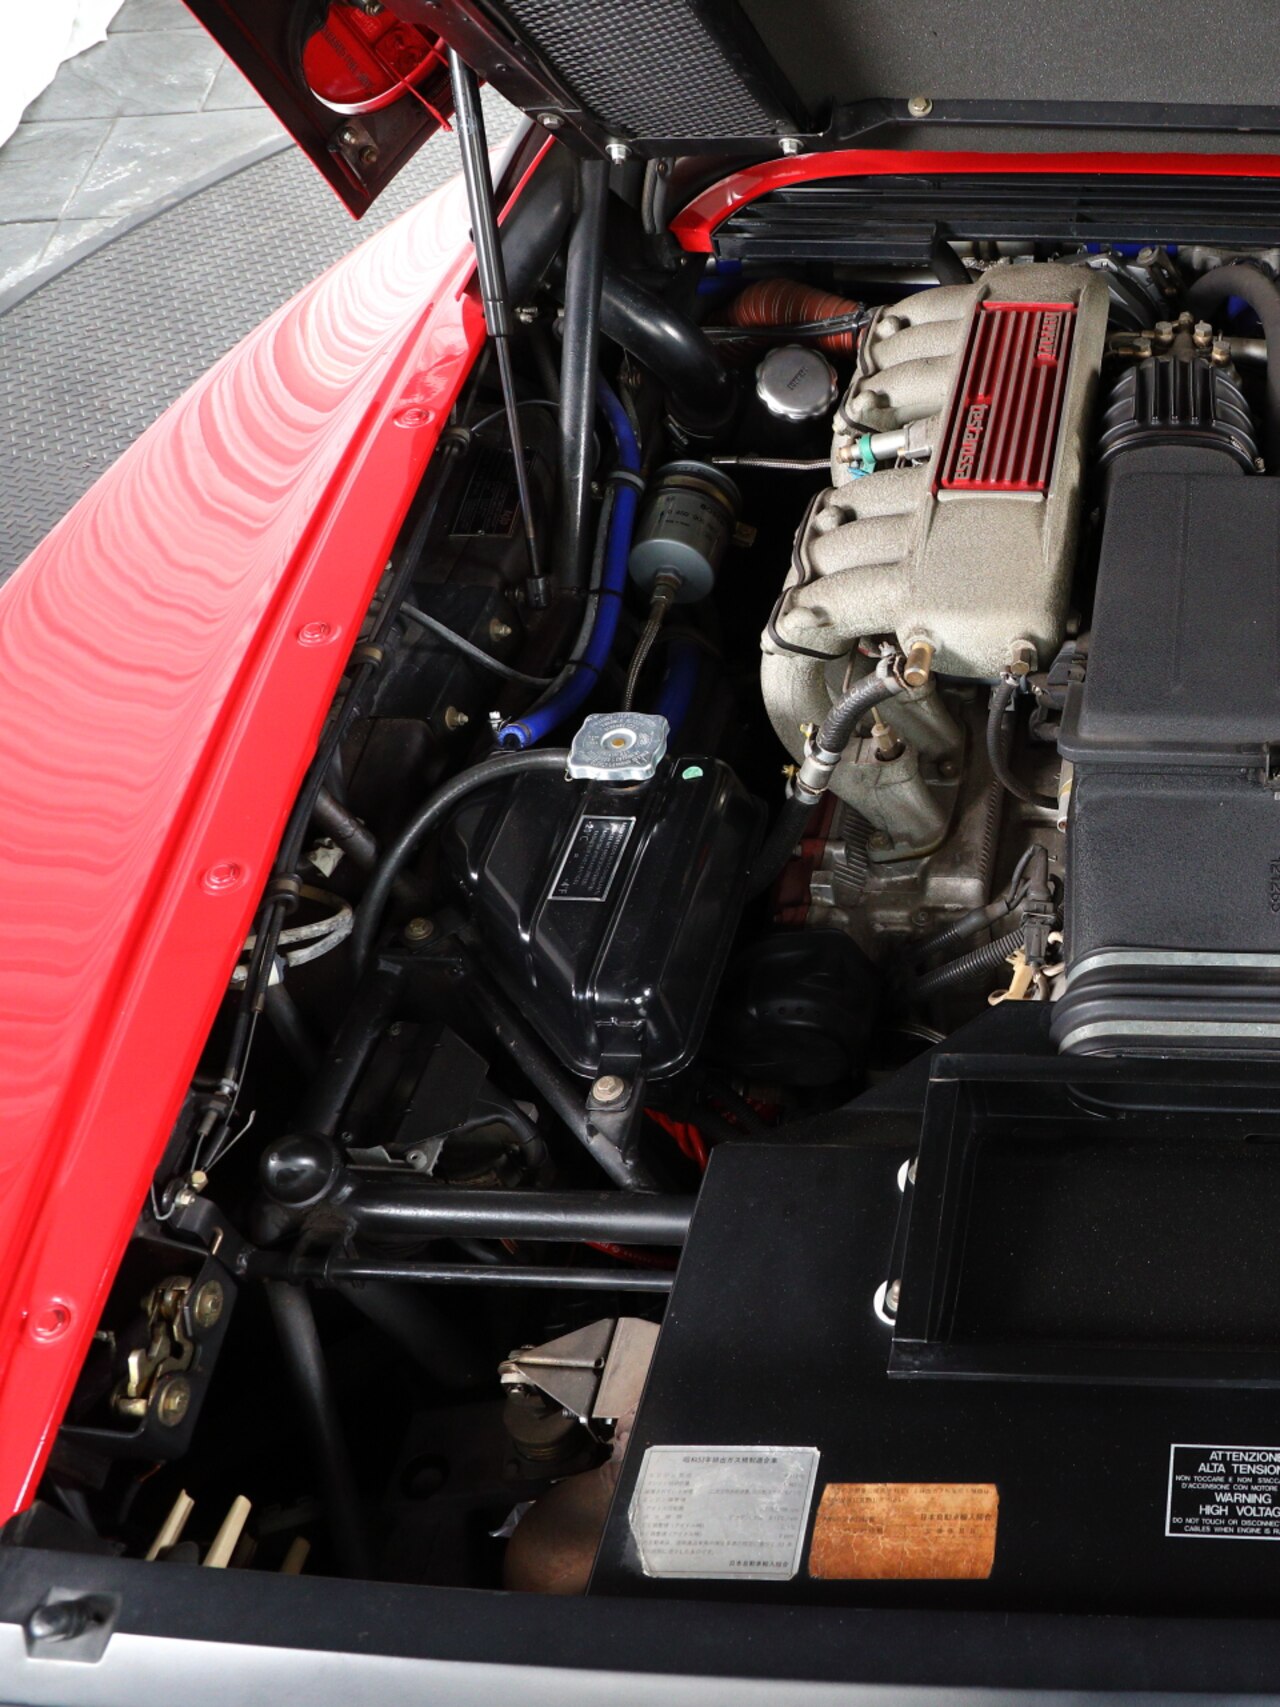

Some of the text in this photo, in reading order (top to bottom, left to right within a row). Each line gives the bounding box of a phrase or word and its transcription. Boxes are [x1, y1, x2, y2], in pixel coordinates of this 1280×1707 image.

[1198, 1463, 1226, 1473] ALTA
[1215, 1492, 1272, 1504] WARNING
[1199, 1505, 1228, 1515] HIGH
